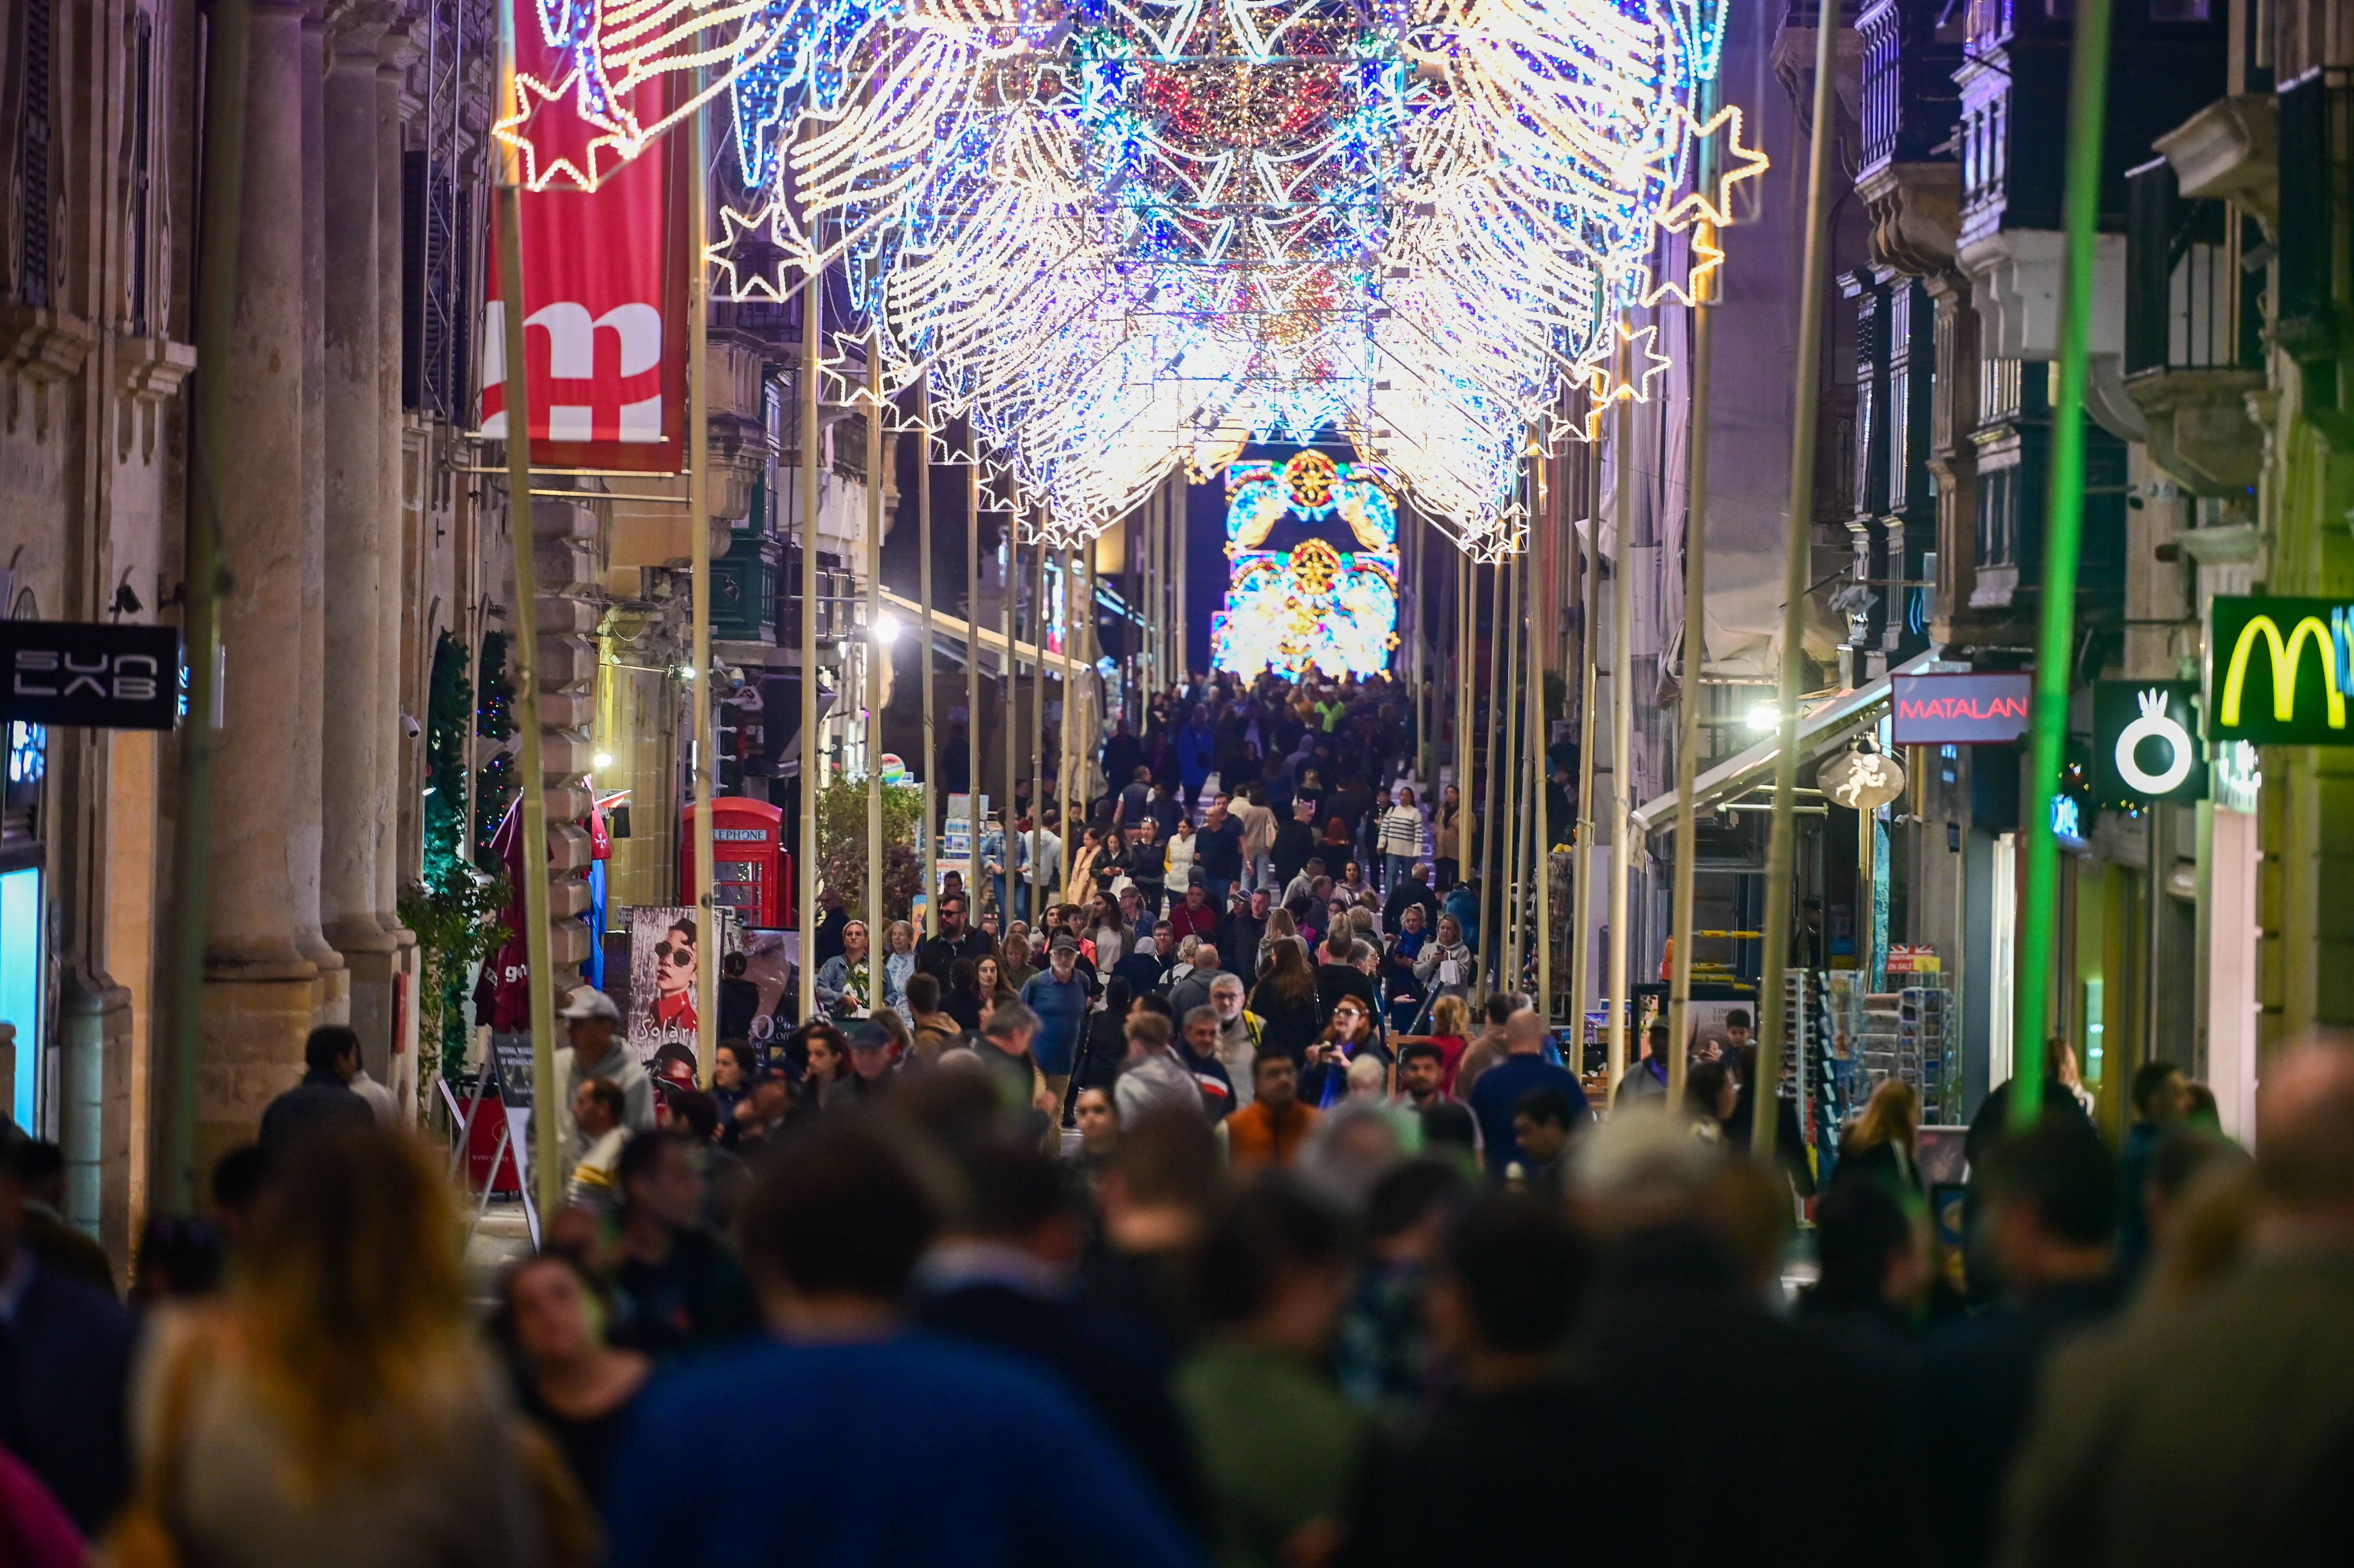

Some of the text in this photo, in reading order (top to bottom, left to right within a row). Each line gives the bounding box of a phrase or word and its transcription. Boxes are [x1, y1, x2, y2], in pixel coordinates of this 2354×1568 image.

[14, 673, 156, 699] LAB
[1900, 697, 2028, 719] MATALAN
[713, 830, 764, 840] LEPHONE
[638, 1017, 698, 1040] Solari
